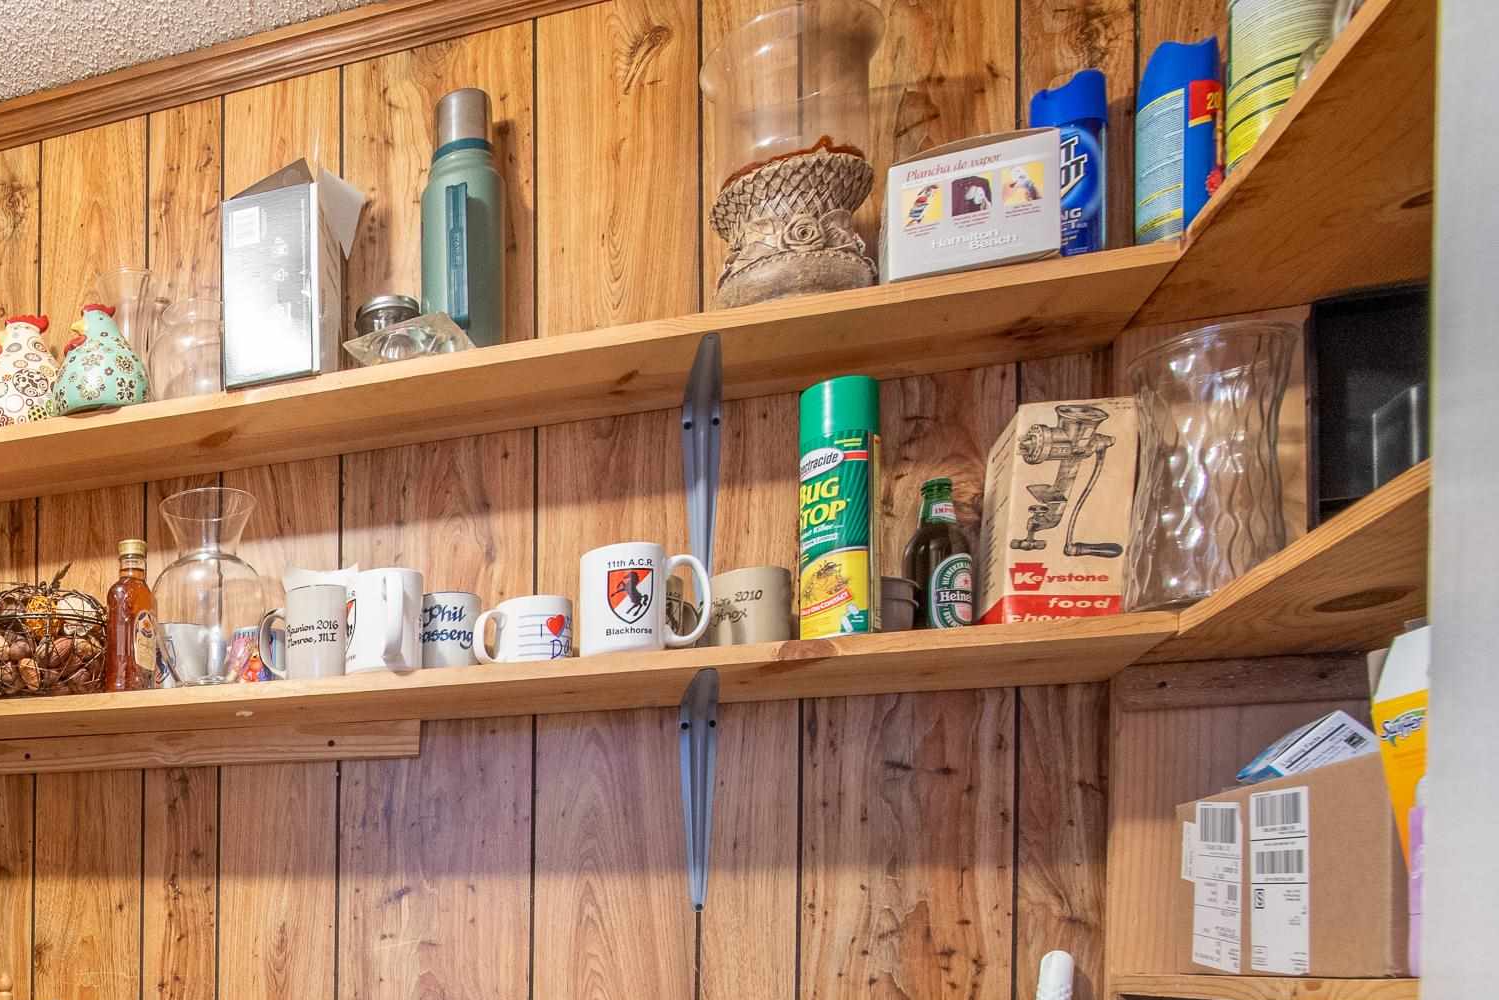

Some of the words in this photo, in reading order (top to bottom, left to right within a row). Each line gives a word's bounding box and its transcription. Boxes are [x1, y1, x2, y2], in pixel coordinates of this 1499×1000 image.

[906, 164, 951, 182] Plancha
[953, 159, 968, 171] de
[970, 152, 1002, 168] vapor
[607, 560, 626, 569] 11th
[1014, 572, 1109, 585] Keystone
[734, 589, 764, 602] 2010
[939, 590, 972, 603] Heine
[1048, 597, 1110, 609] food
[422, 604, 467, 628] Phil
[316, 619, 339, 631] 2016
[605, 627, 653, 637] Blackhorse
[420, 628, 474, 650] asseng
